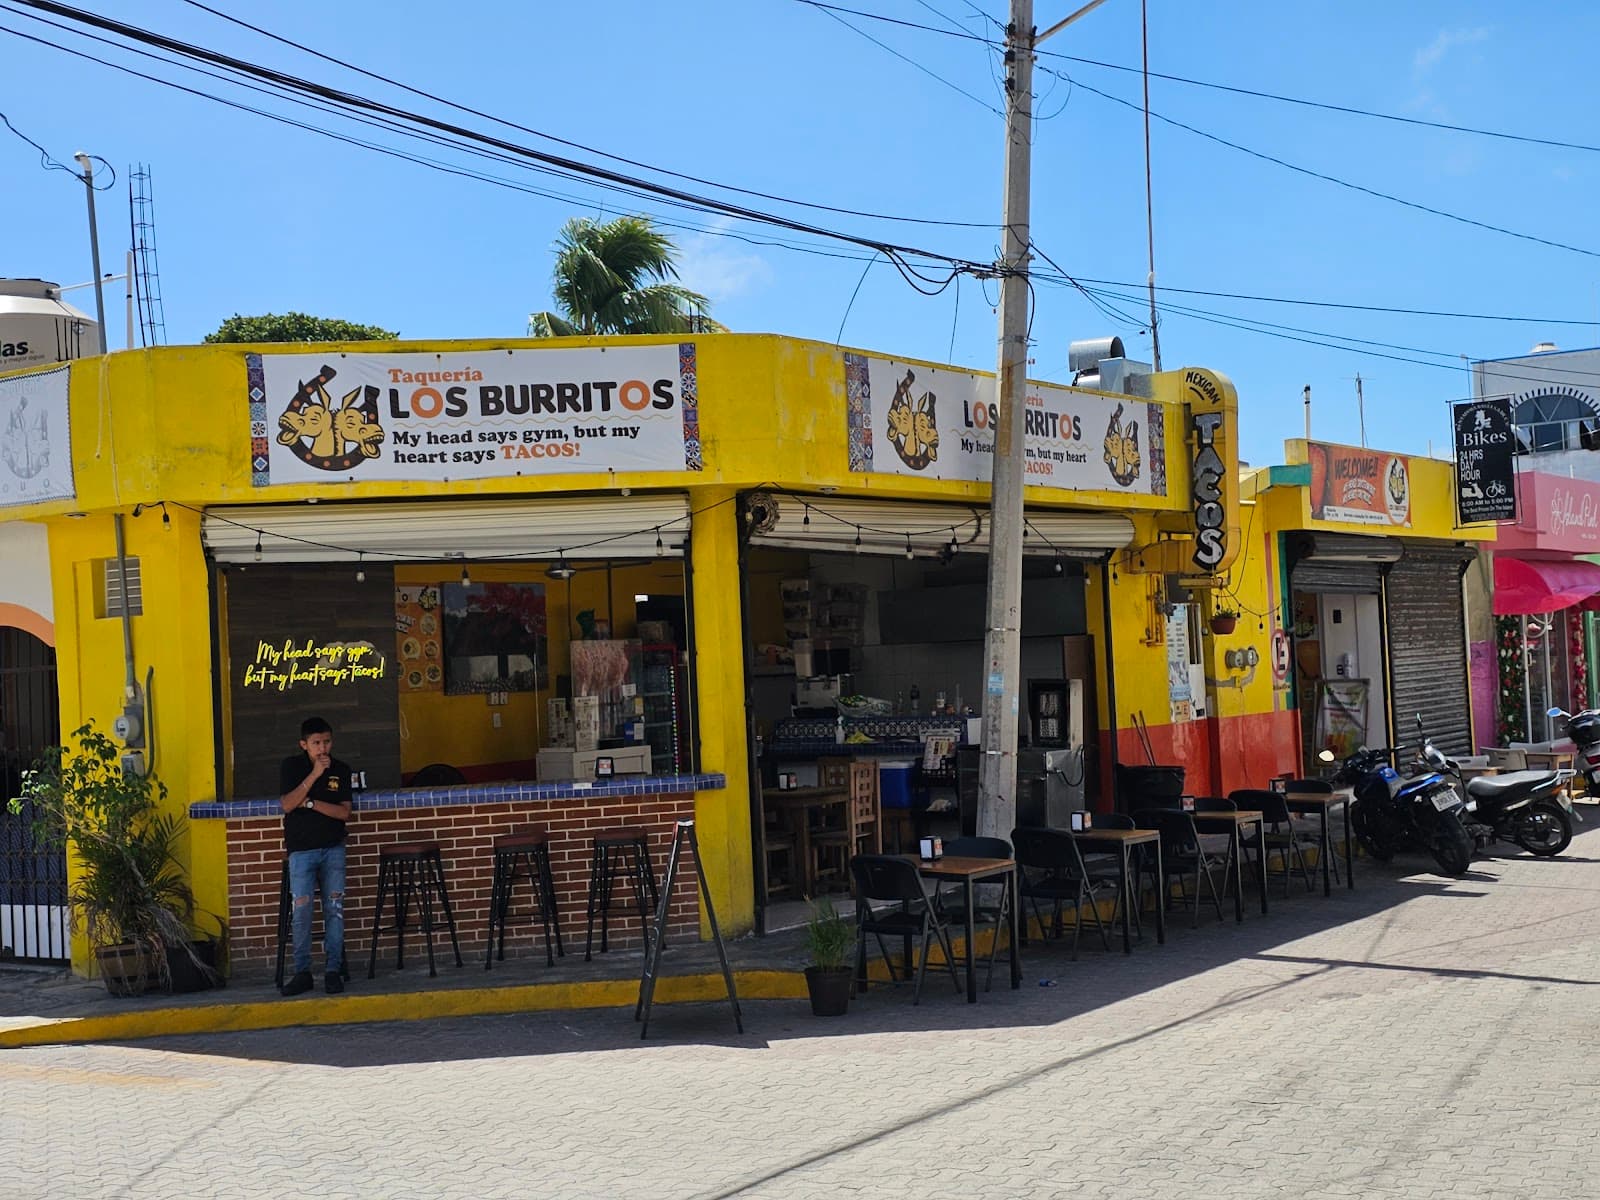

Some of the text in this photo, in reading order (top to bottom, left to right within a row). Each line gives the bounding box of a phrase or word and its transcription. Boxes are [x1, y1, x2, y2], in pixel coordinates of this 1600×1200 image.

[388, 366, 483, 386] Taquería
[1185, 371, 1221, 405] MEXICAN
[389, 379, 674, 419] LOS BURRITOS
[392, 425, 640, 448] My head says gym, but my
[1025, 408, 1082, 441] RRITOS
[1463, 430, 1508, 447] Bikes
[393, 442, 580, 465] heart says TACOS!
[961, 438, 974, 454] My
[1037, 447, 1052, 460] but
[1052, 451, 1065, 464] my
[1066, 450, 1087, 463] heart
[1459, 449, 1484, 462] 24 HRS
[1460, 461, 1475, 472] DAY
[1460, 469, 1481, 481] HOUR
[1192, 412, 1226, 570] TACOS
[256, 640, 281, 666] My
[283, 639, 313, 661] head
[315, 646, 345, 663] says
[244, 657, 384, 691] but my heart says tacos!
